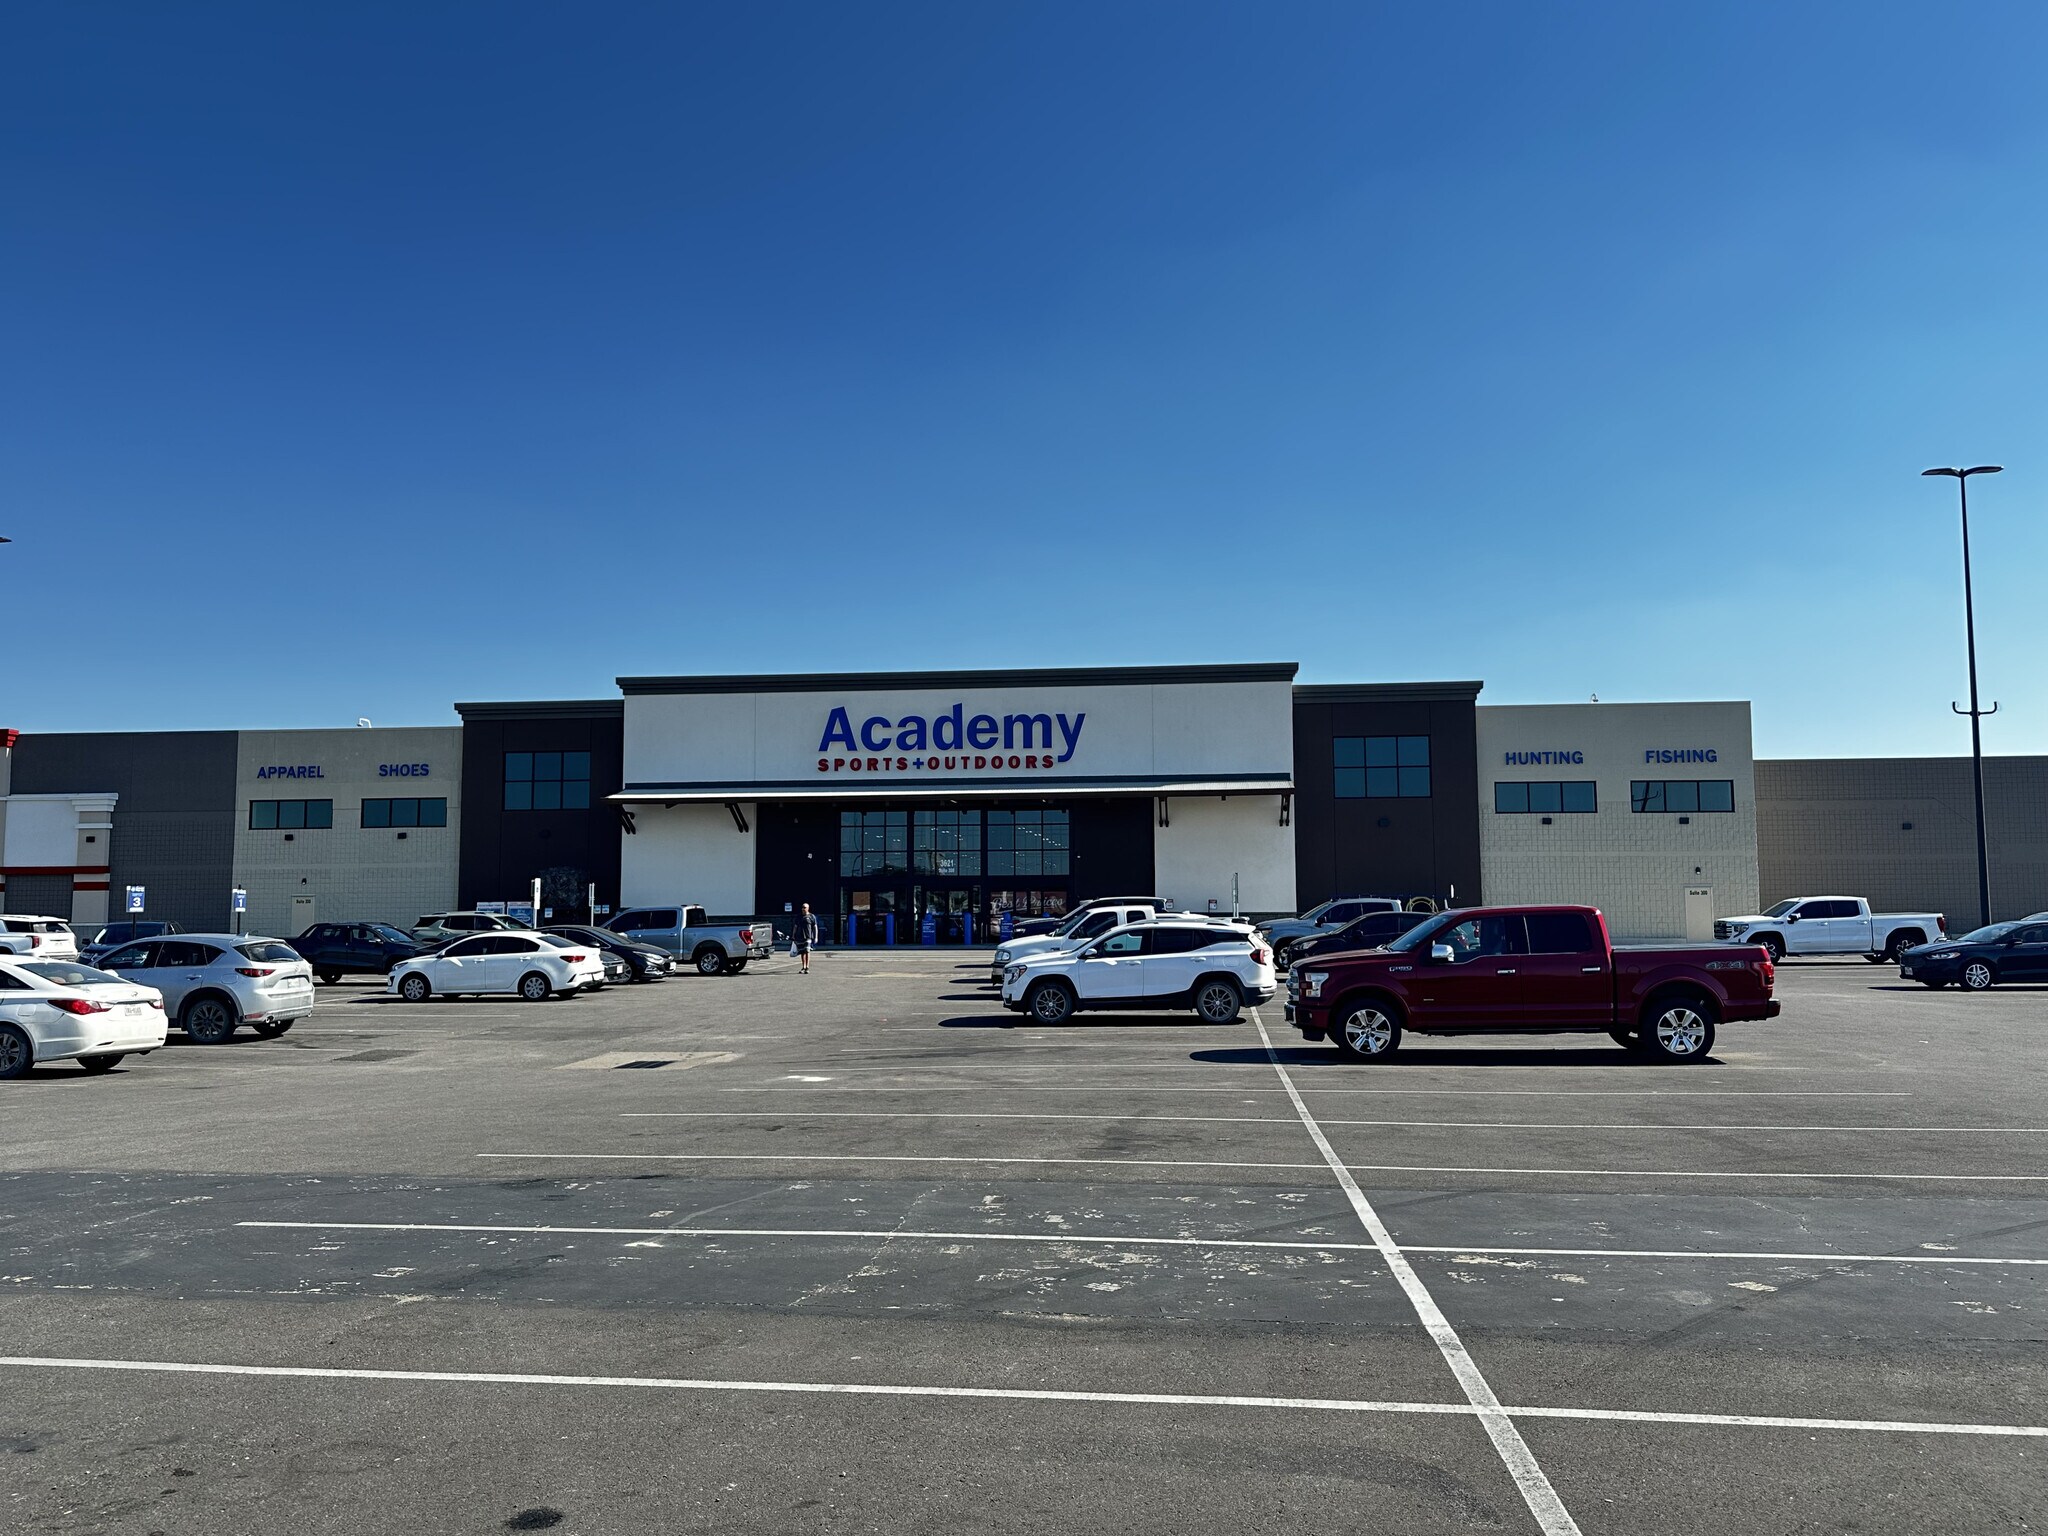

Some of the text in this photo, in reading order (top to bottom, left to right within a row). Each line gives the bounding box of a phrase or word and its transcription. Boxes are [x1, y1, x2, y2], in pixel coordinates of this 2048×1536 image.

[818, 703, 1086, 763] Academy
[1505, 751, 1584, 766] HUNTING
[1645, 749, 1718, 764] FISHING
[257, 766, 325, 779] APPAREL
[378, 764, 430, 777] SHOES
[133, 897, 141, 907] 3
[238, 899, 243, 908] 1
